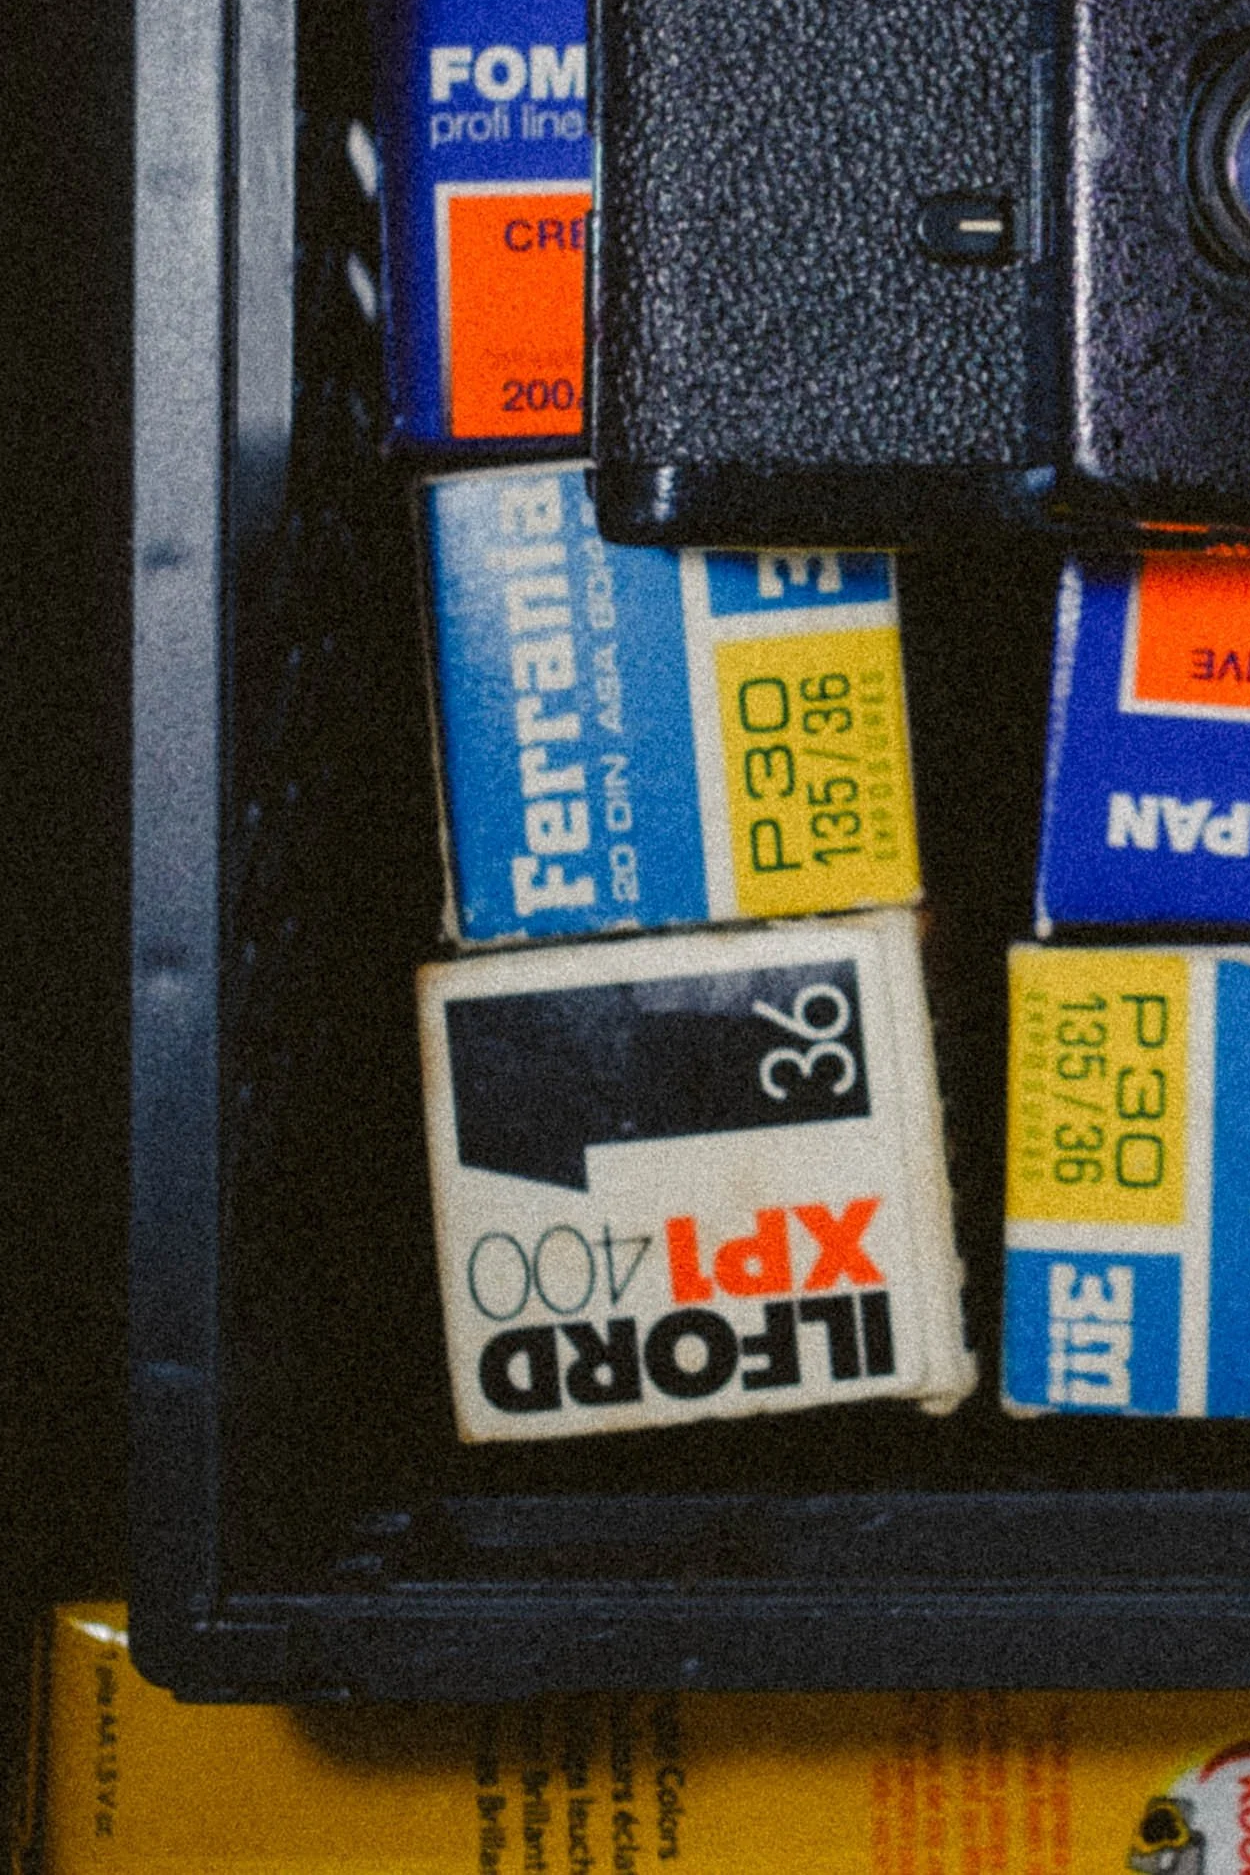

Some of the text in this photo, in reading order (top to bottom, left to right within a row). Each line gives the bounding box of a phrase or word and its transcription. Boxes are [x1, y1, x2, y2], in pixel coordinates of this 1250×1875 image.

[502, 378, 583, 413] 200
[484, 477, 596, 918] Ferrania
[589, 641, 622, 735] ASA
[601, 752, 633, 833] DIN
[607, 844, 641, 903] 20
[752, 981, 857, 1101] 36
[467, 1194, 887, 1322] XP1 400
[478, 1289, 897, 1416] ILFORD
[655, 1766, 685, 1860] Colors
